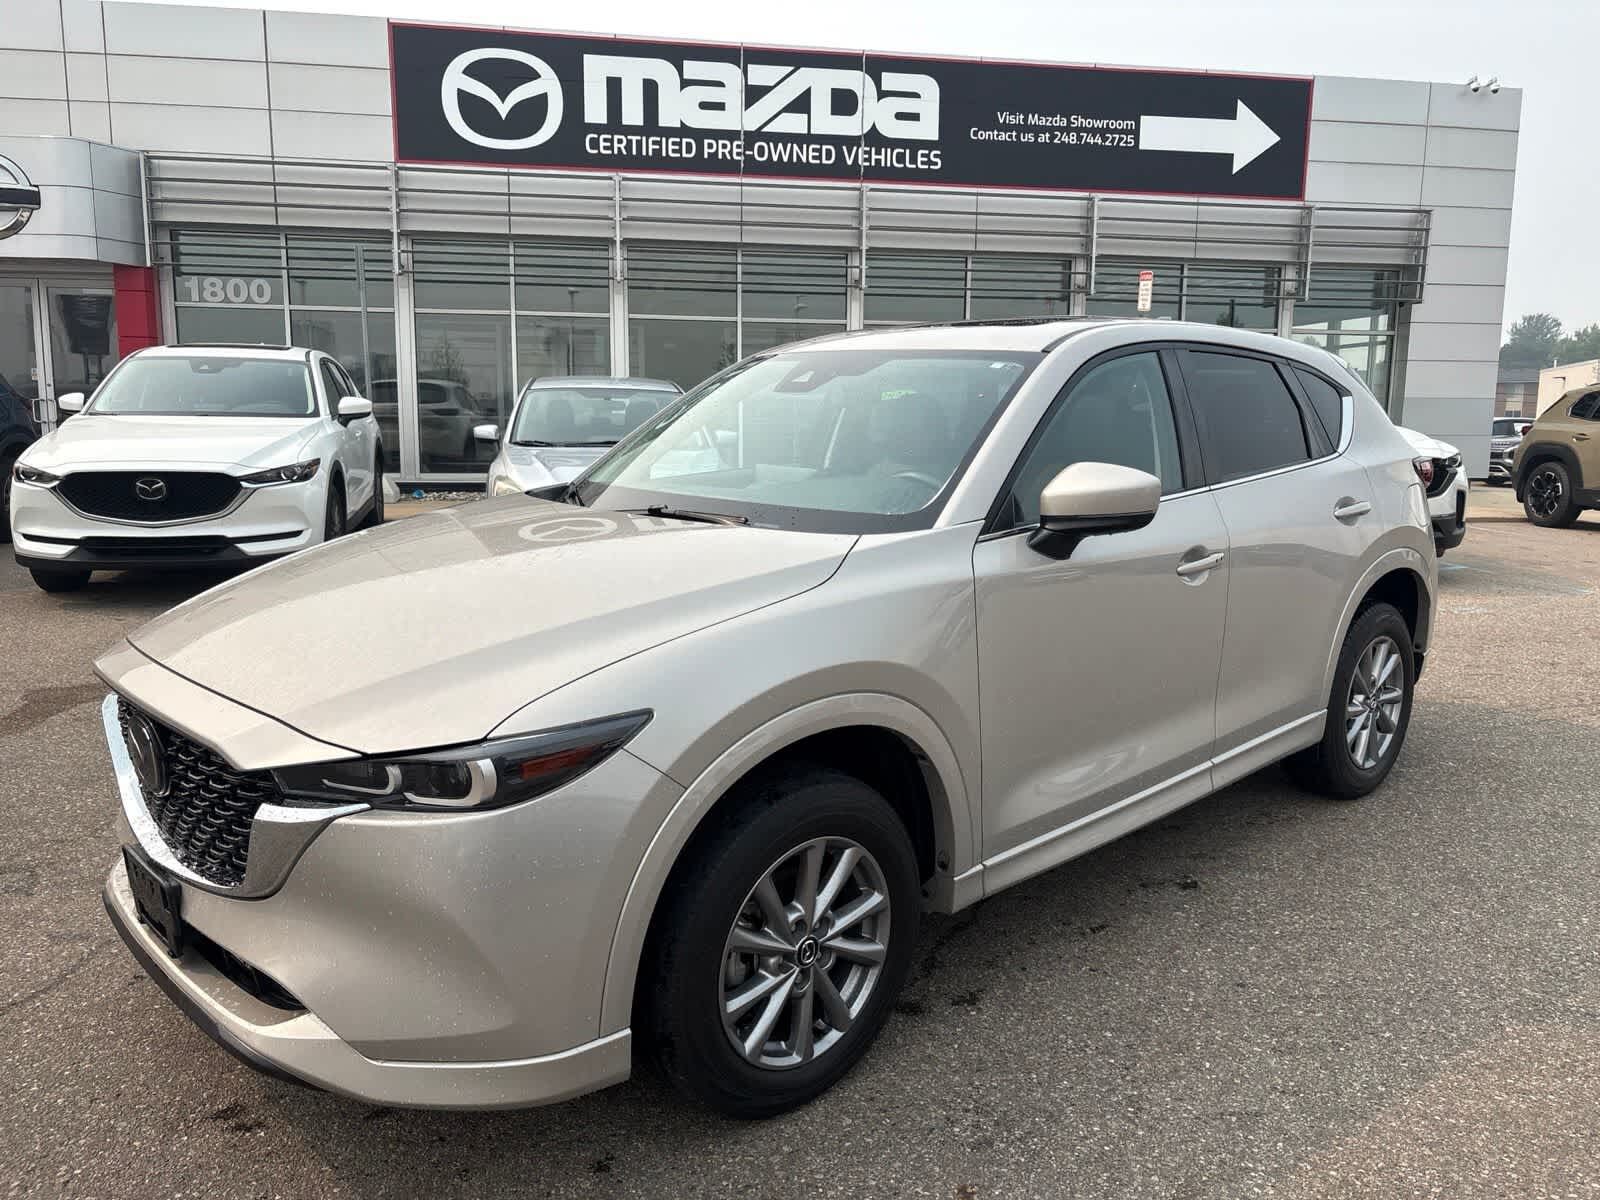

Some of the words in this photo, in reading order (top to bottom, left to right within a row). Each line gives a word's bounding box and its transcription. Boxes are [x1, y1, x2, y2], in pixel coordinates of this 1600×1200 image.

[997, 111, 1025, 125] Visit
[1027, 113, 1067, 127] Mazda
[1070, 115, 1136, 130] Showroom
[969, 127, 1017, 142] Contact
[1020, 132, 1035, 143] us
[1037, 132, 1051, 144] at
[1053, 131, 1135, 147] 248.744.2725
[585, 133, 697, 159] CERTIFIED
[703, 139, 836, 165] PRE-OWNED
[842, 145, 942, 170] VEHICLES
[184, 277, 272, 304] 1800
